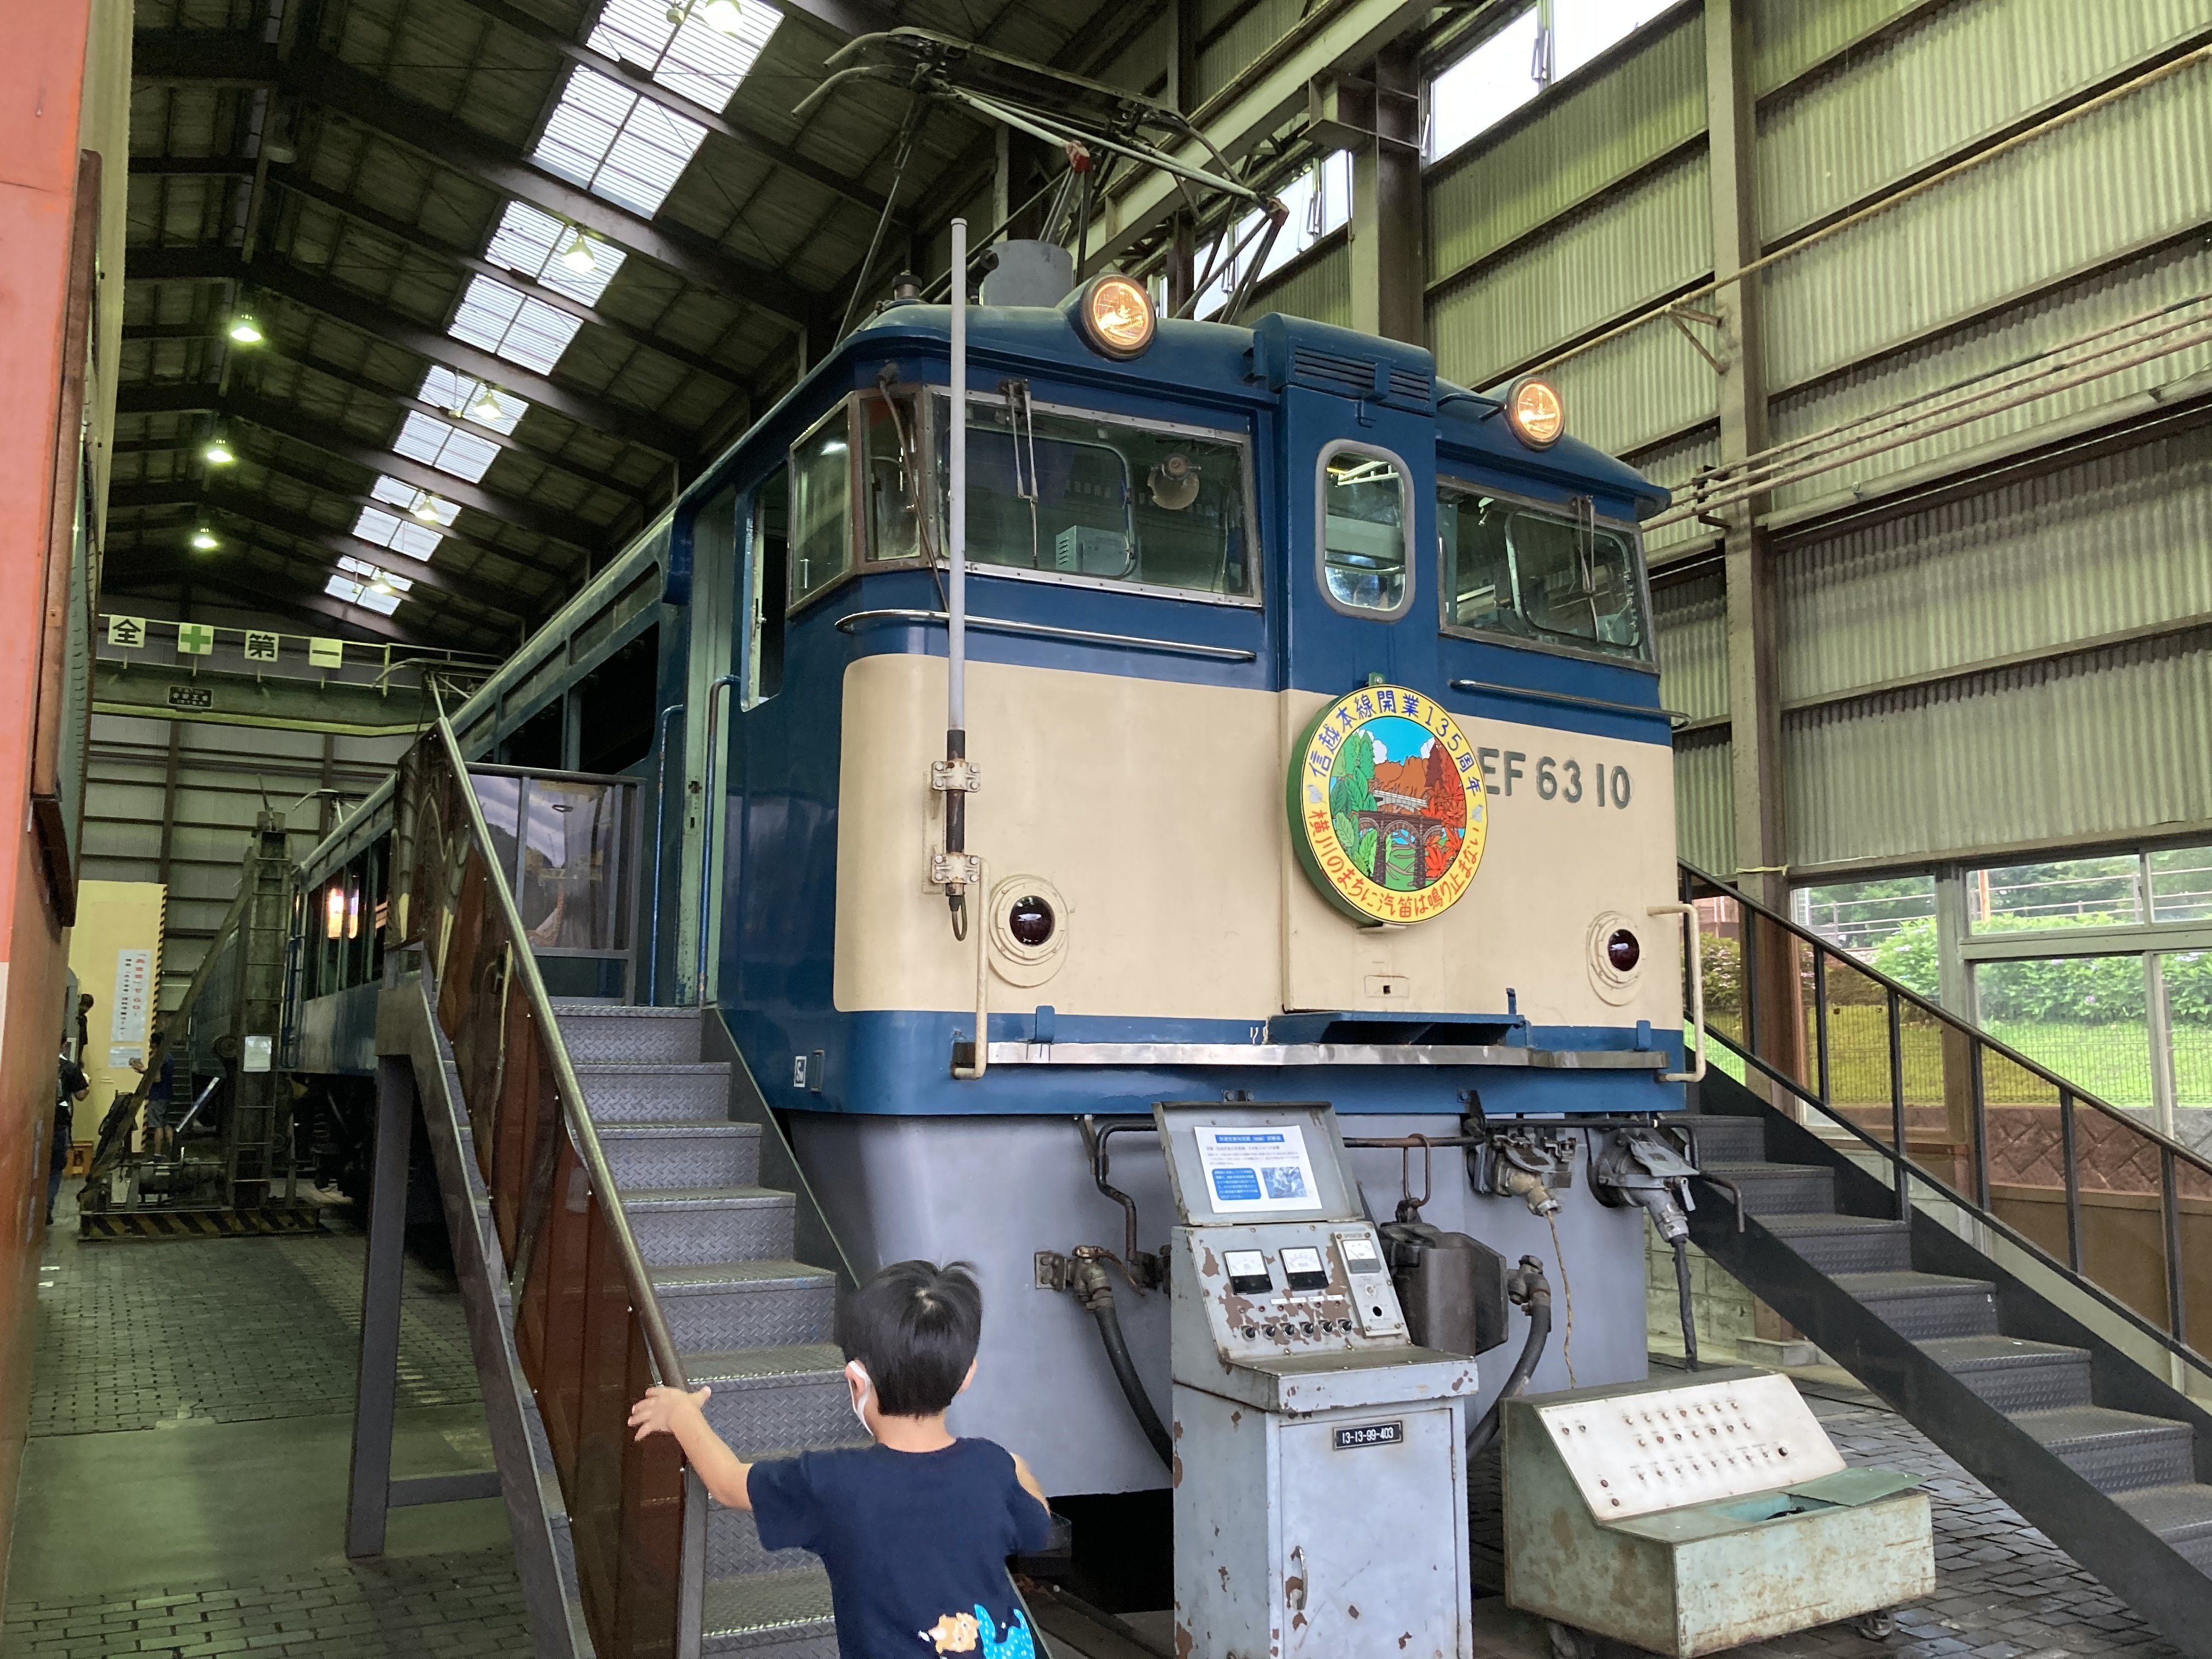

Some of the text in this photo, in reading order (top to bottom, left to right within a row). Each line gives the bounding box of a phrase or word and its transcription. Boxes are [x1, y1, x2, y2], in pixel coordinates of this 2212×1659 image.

[113, 619, 142, 645] 全
[249, 634, 276, 658] 第
[1308, 690, 1481, 797] 信越本線開業135周年
[1308, 809, 1480, 918] 横川のまちに汽笛は鳴り止まない
[1342, 1426, 1394, 1444] 13-13-99-403
